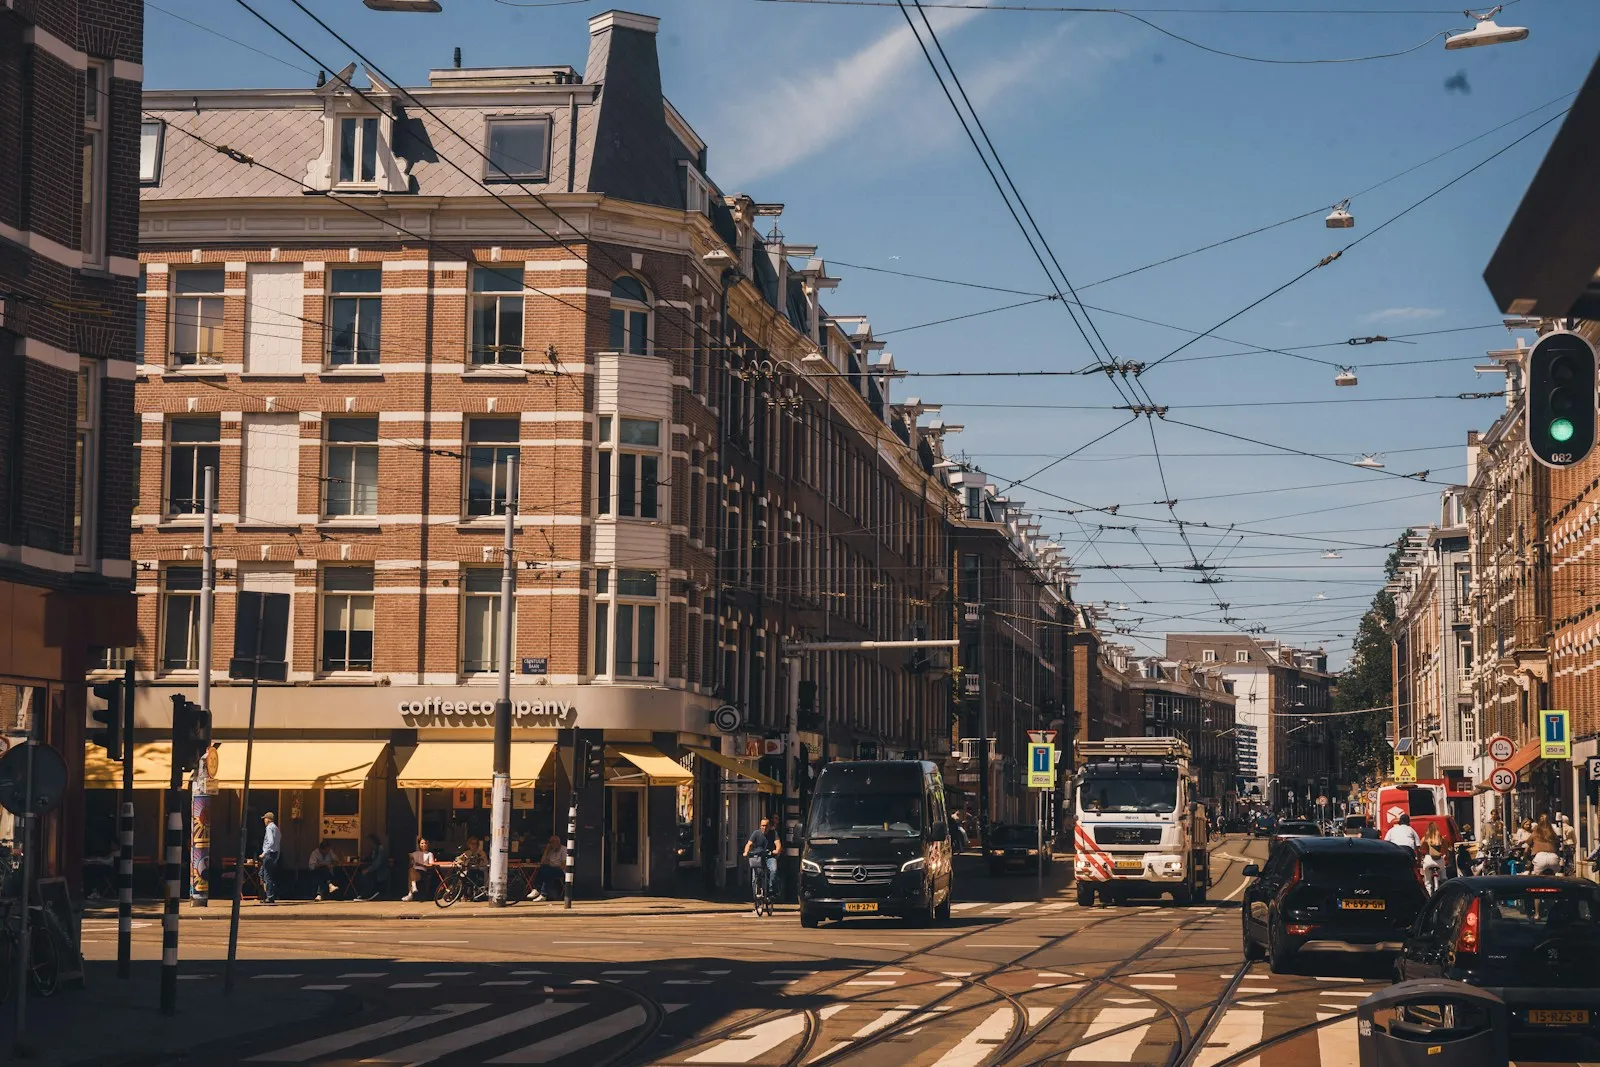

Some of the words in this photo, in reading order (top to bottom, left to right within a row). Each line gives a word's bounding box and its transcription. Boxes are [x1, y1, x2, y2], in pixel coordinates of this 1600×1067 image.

[1551, 453, 1572, 462] 082
[397, 696, 573, 720] coffeecopany
[1495, 774, 1512, 785] 30
[1456, 781, 1472, 792] FE
[1533, 1011, 1584, 1022] 15-RZS-8
